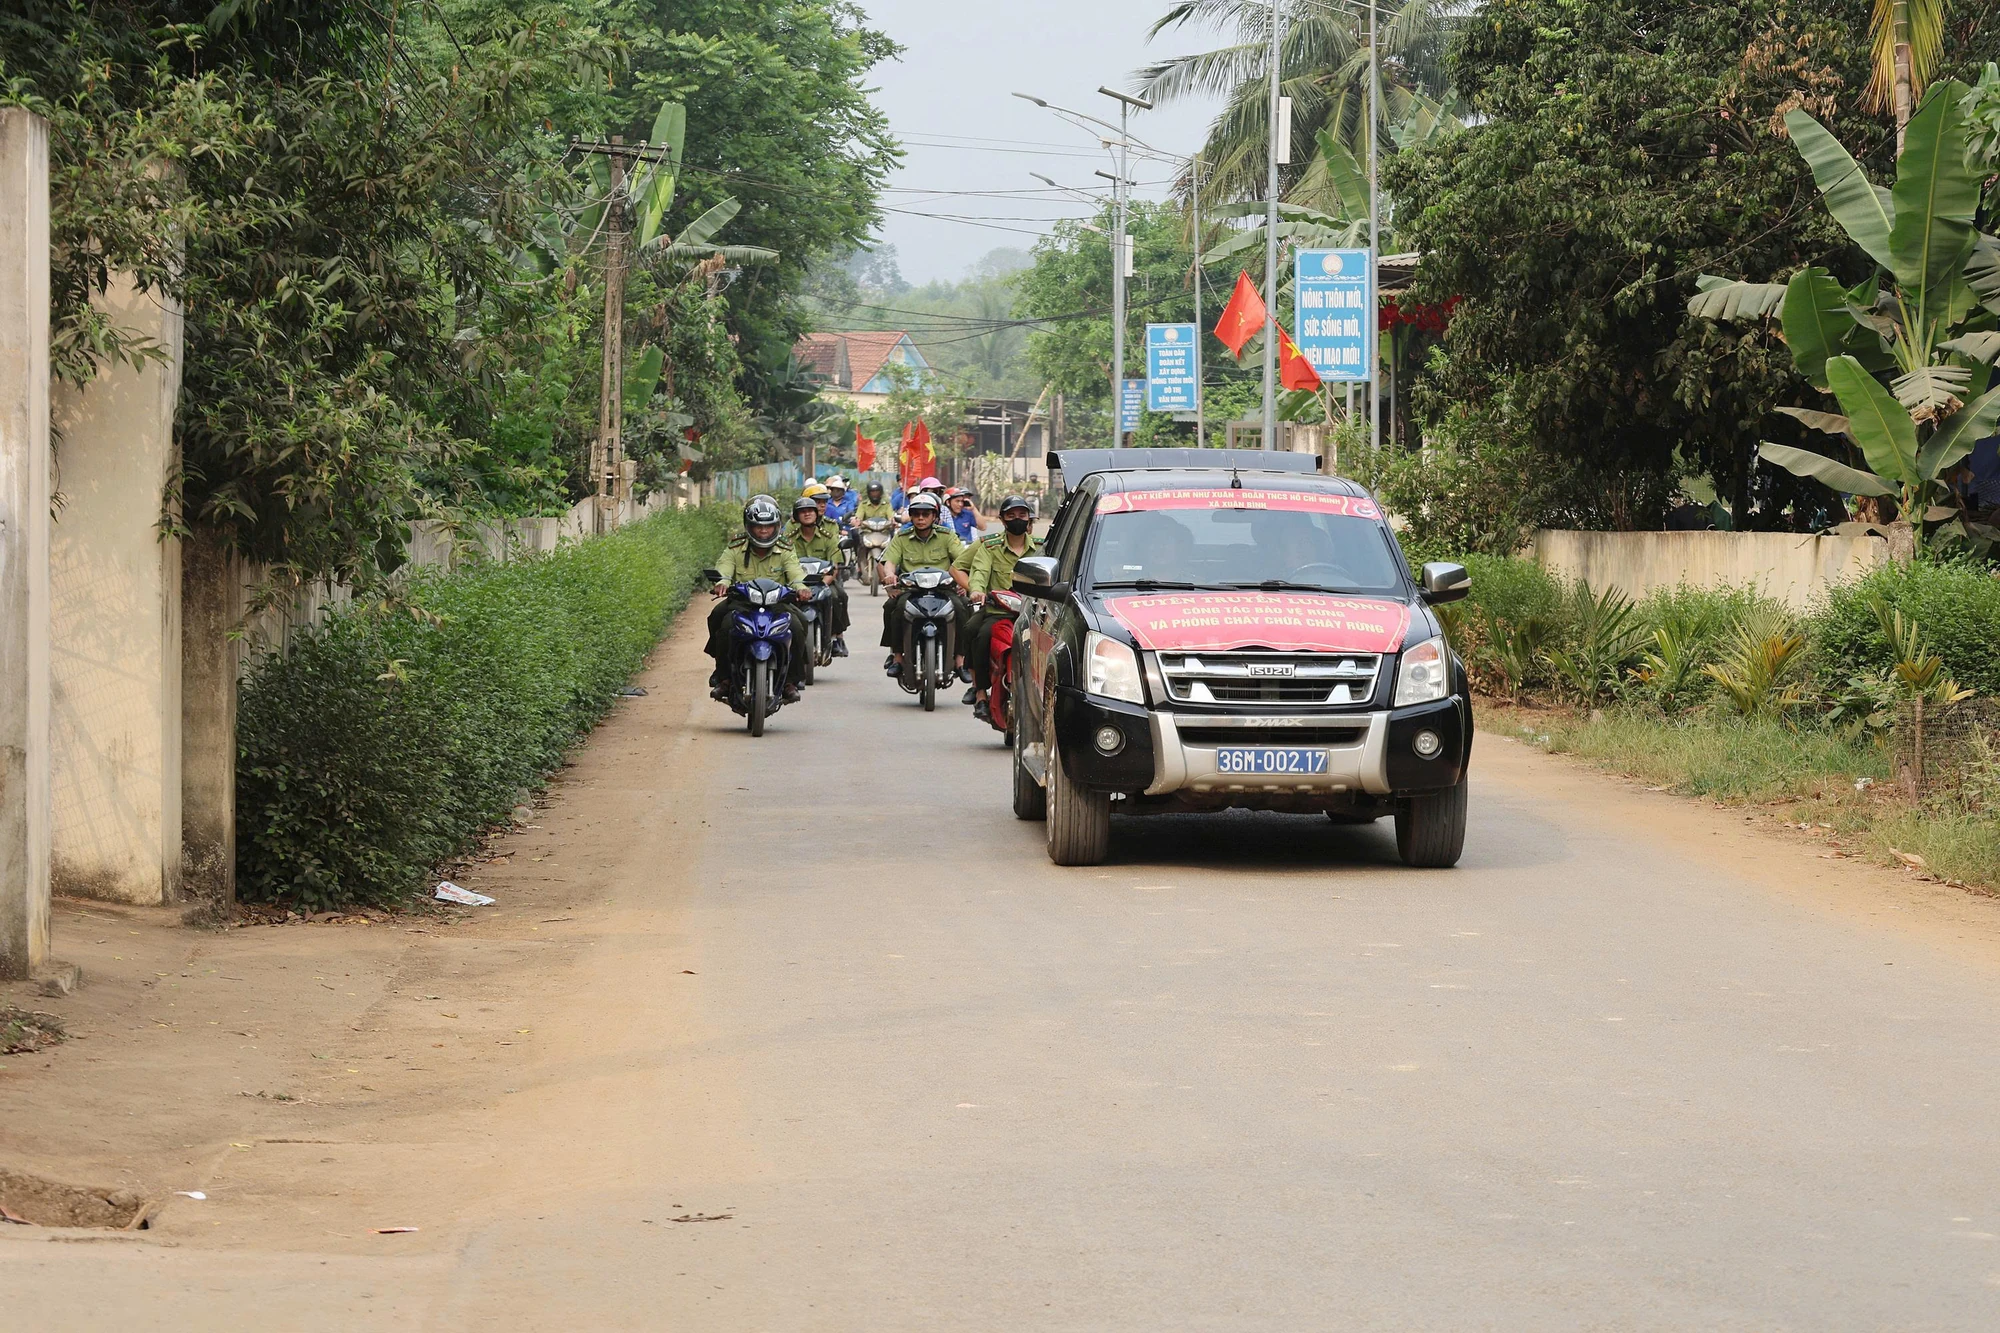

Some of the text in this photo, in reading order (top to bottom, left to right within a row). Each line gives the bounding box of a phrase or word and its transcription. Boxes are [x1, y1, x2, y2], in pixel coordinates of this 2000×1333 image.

[1302, 286, 1363, 310] NÔNG THÔN MỚI,
[1304, 313, 1361, 338] SỨC SỐNG MỚI,
[1324, 347, 1341, 368] MẠO
[1343, 342, 1360, 364] MỚI!
[1212, 490, 1235, 498] XUÂN
[1267, 492, 1288, 500] TNCS
[1319, 497, 1341, 505] MINH
[1222, 500, 1245, 508] XUÂN
[1129, 596, 1196, 608] TUYÊN
[1286, 597, 1326, 606] LƯU
[1332, 600, 1388, 612] ĐỘNG
[1223, 605, 1250, 614] TÁC
[1286, 607, 1303, 616] VỆ
[1149, 619, 1168, 630] VÀ
[1251, 667, 1292, 675] ISUZU
[1219, 750, 1327, 772] 36M-002.17
